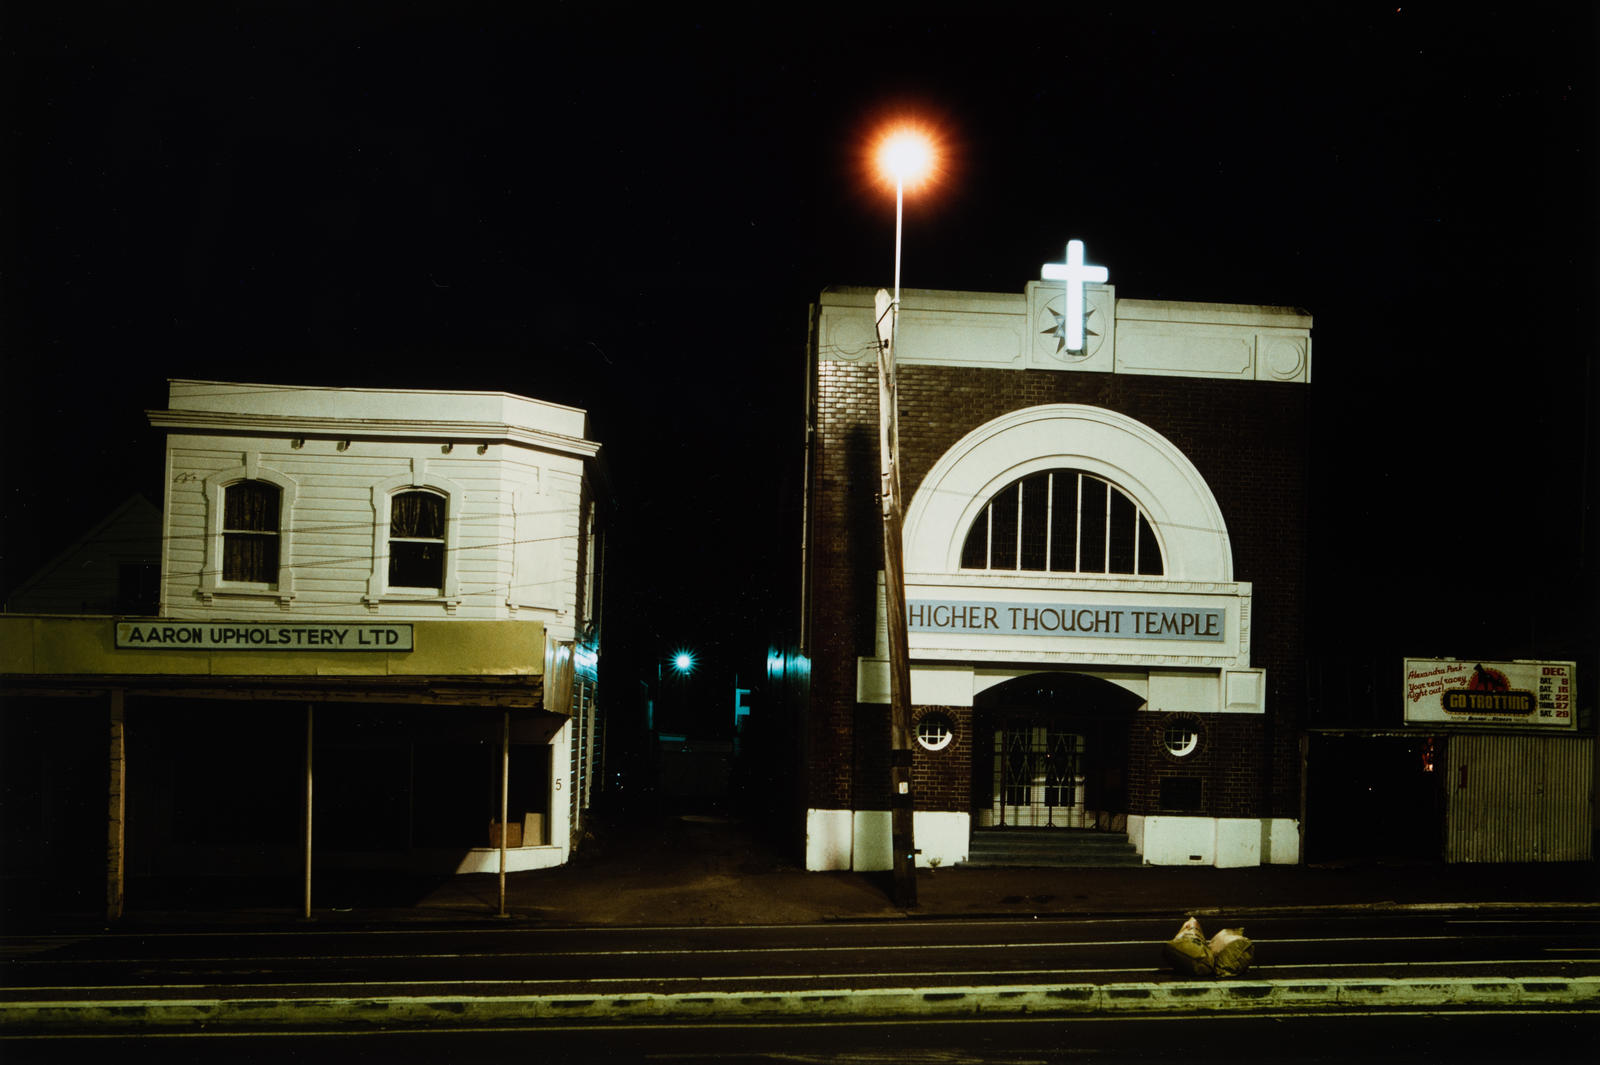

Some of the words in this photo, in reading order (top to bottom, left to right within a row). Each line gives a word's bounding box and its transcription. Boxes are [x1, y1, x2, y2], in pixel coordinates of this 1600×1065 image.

[908, 604, 1000, 630] HIGHER
[1008, 607, 1125, 634] THOUGHT
[1131, 611, 1220, 637] TEMPLE
[128, 627, 202, 645] AARON
[210, 628, 349, 646] UPHOLSTERY
[358, 629, 399, 646] LTD
[1407, 667, 1446, 680] Alexandra
[1542, 667, 1567, 676] DEC.
[1408, 683, 1426, 693] Your
[1449, 693, 1467, 708] GO
[1469, 694, 1529, 710] TROTTING
[555, 778, 562, 791] 5
